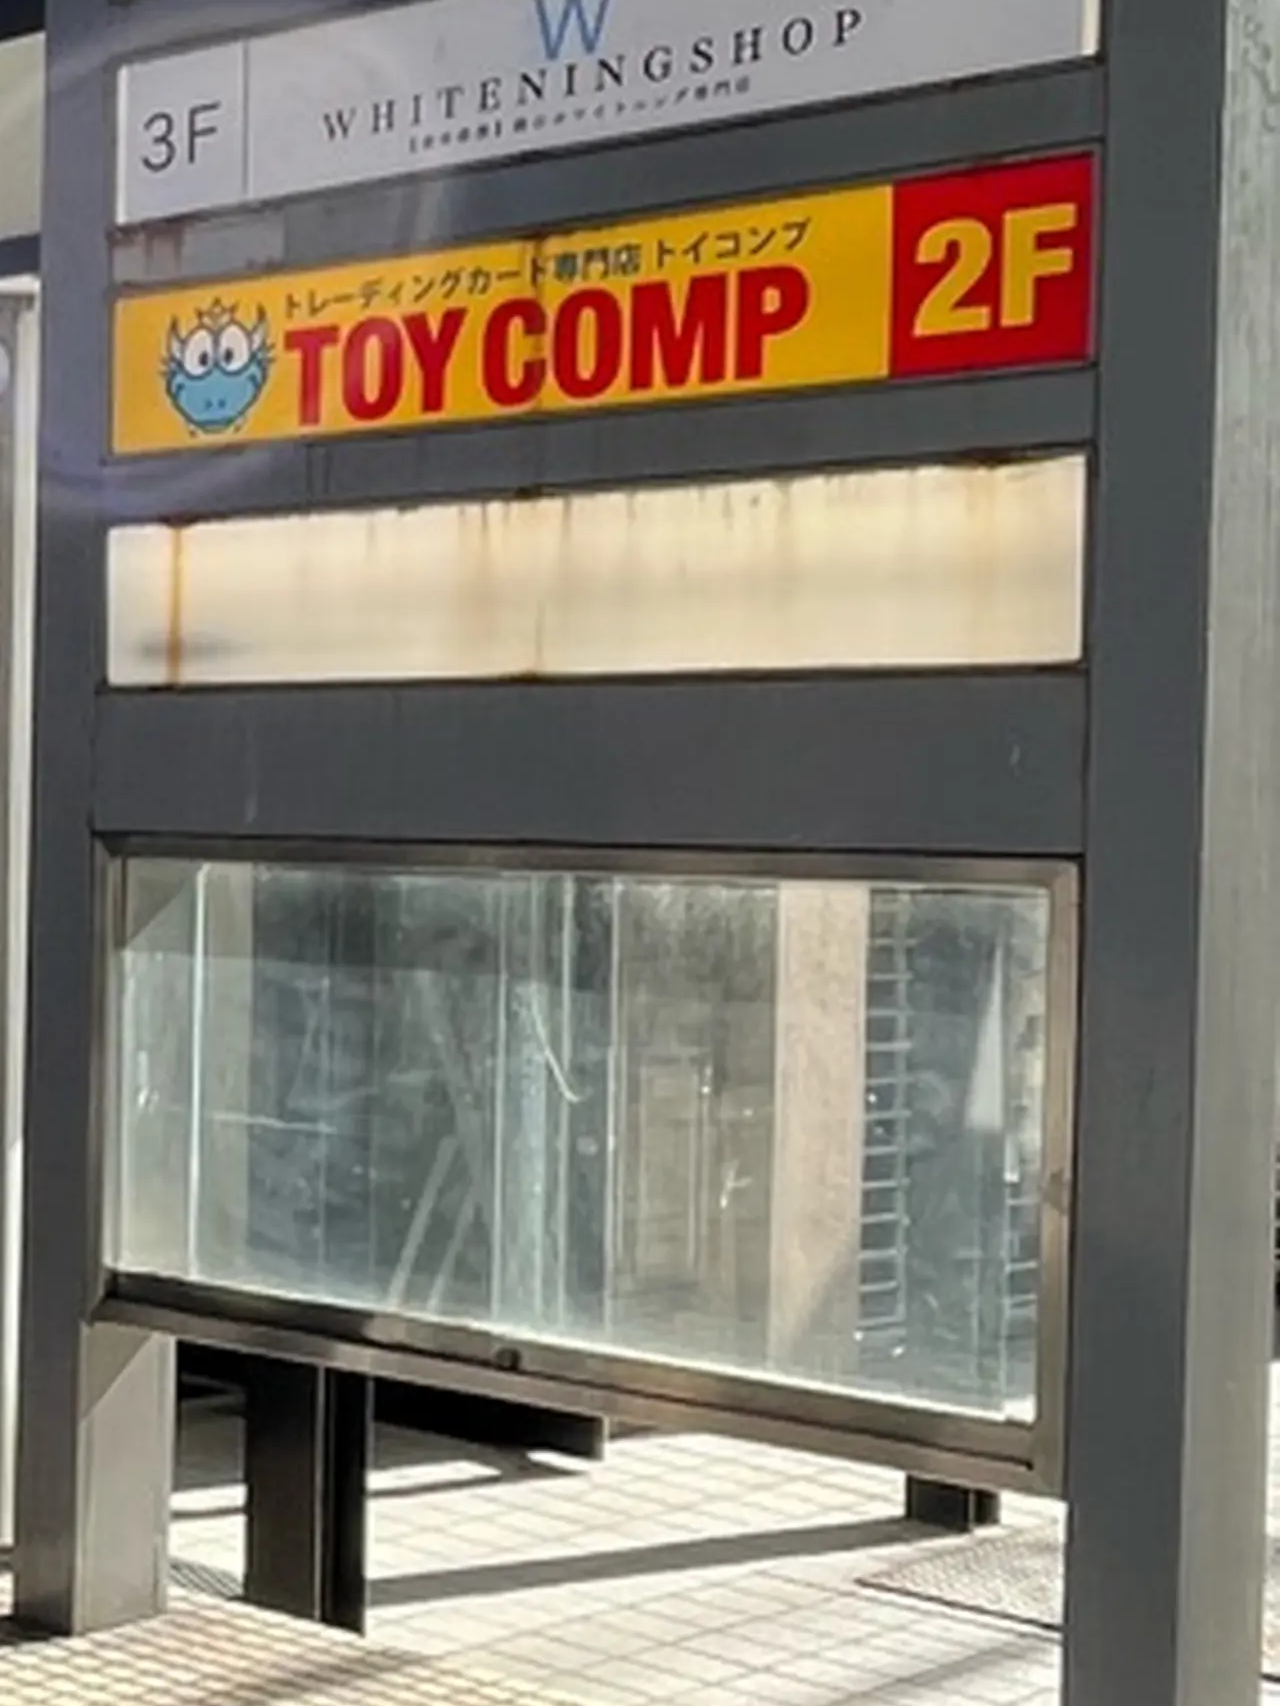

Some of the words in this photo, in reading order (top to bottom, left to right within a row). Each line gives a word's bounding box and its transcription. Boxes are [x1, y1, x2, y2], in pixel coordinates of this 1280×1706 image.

[141, 102, 223, 173] 3F
[653, 217, 813, 270] トイコンプ
[911, 203, 1081, 339] 2F
[285, 303, 468, 428] TOY
[482, 263, 808, 411] COMP
